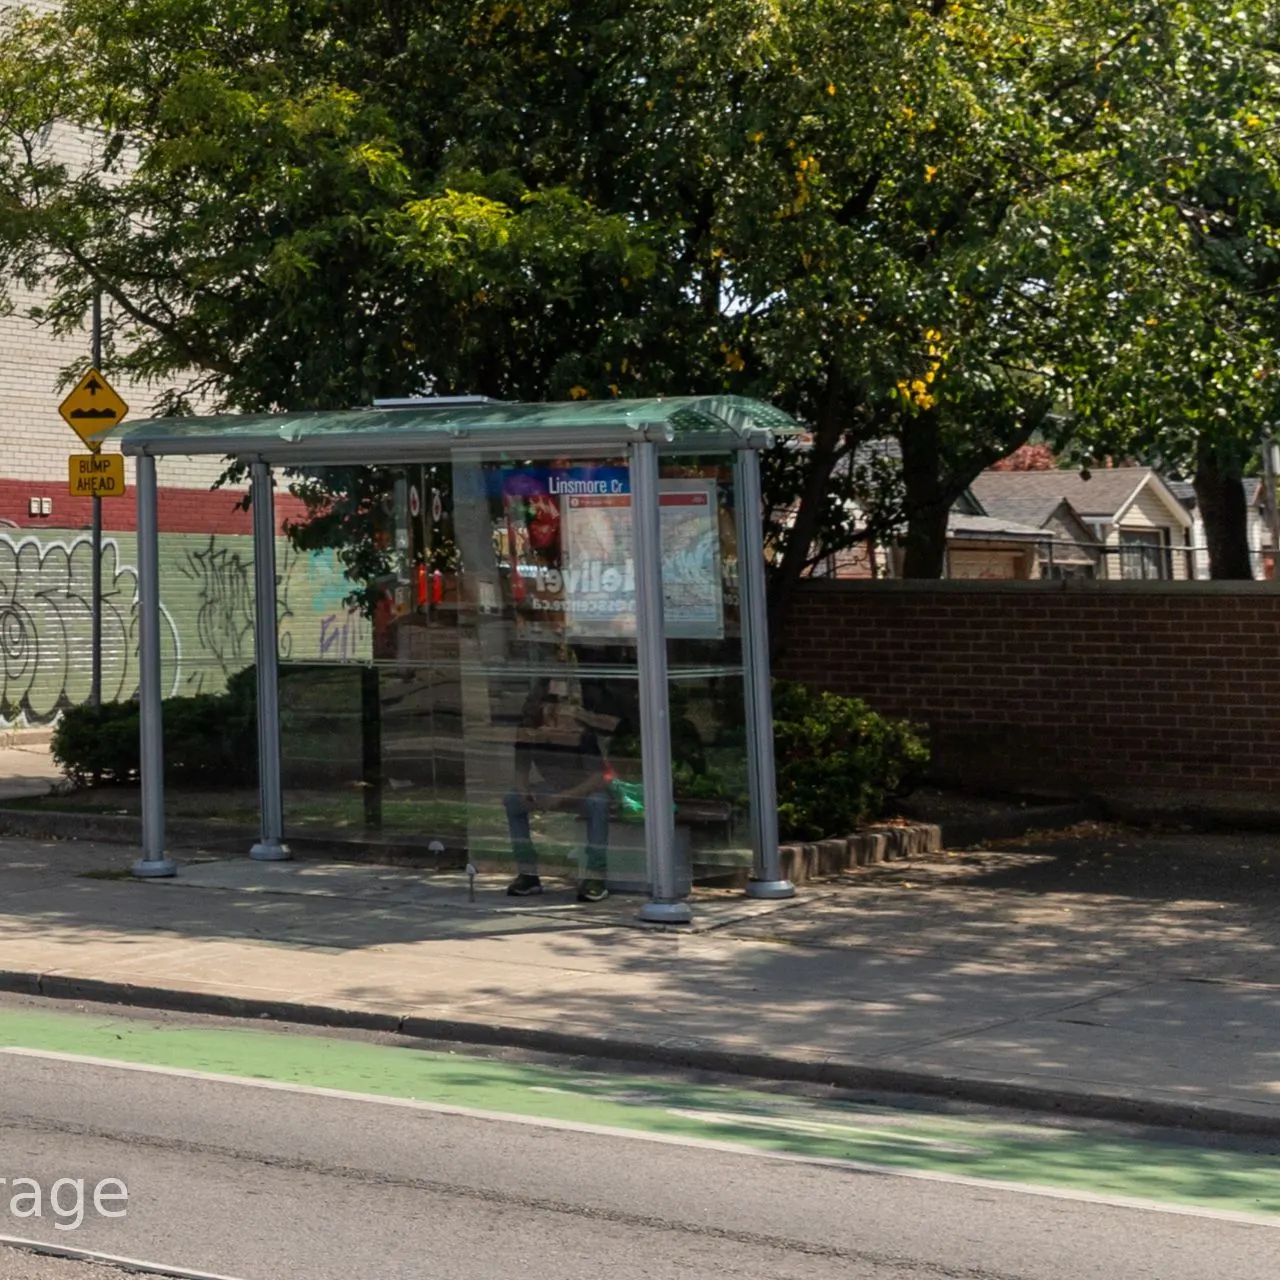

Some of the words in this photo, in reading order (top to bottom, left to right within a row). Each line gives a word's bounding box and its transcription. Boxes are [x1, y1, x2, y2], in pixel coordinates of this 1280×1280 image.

[79, 459, 111, 474] BUMP
[77, 476, 115, 491] AHEAD
[549, 476, 608, 494] Linsmore
[611, 479, 624, 494] Cr
